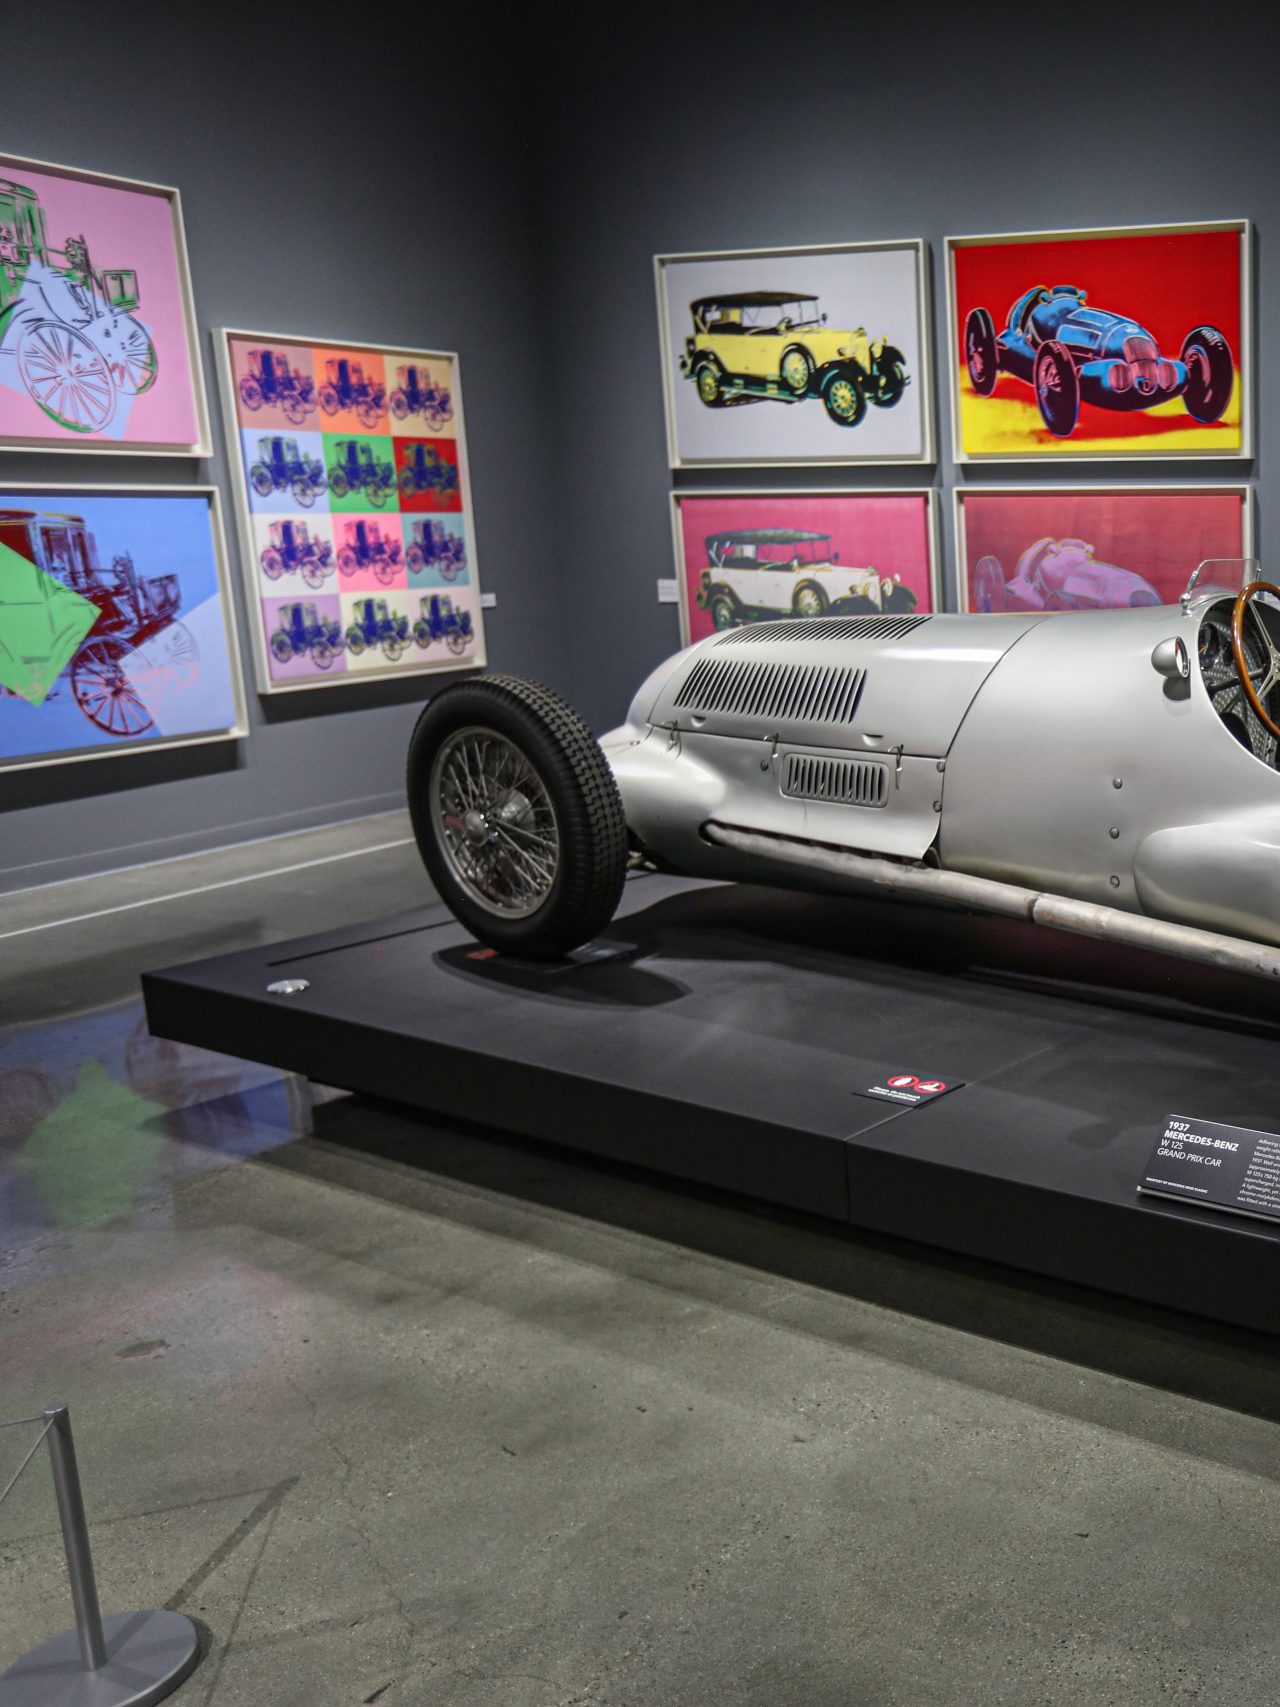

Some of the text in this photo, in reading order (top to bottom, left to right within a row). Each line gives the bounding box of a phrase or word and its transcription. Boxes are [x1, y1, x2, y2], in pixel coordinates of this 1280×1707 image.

[1169, 1121, 1190, 1131] 1937
[1164, 1130, 1239, 1151] MERCEDES-BENZ
[1171, 1141, 1184, 1149] 125
[1157, 1148, 1222, 1167] GRAND PRIX CAR
